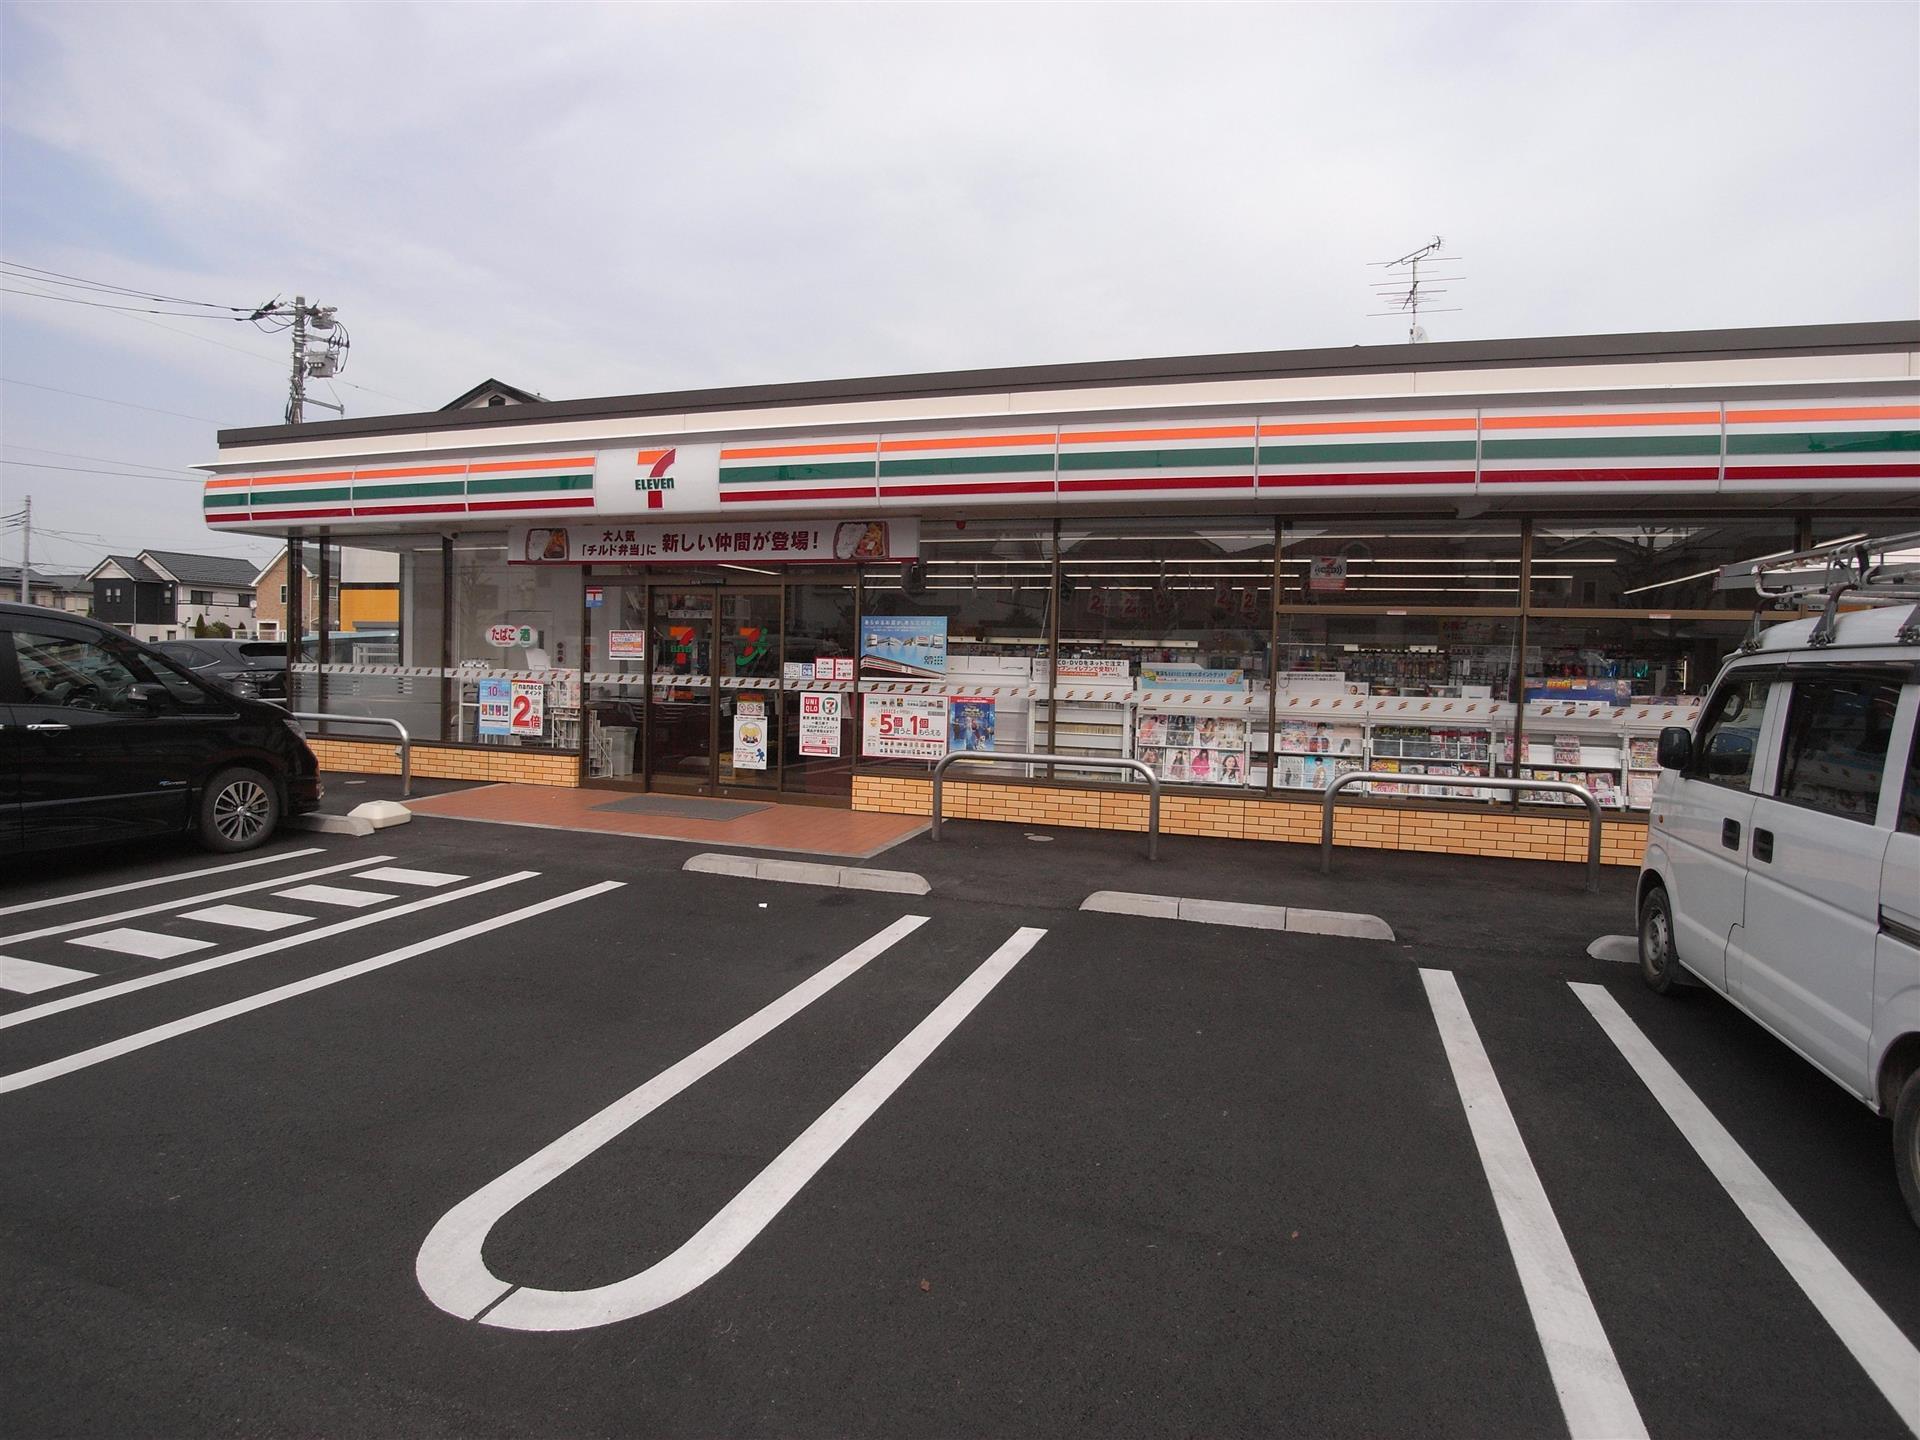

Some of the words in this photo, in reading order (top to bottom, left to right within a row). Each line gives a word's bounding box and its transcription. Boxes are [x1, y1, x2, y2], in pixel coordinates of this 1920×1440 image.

[637, 448, 677, 509] 7
[602, 530, 636, 542] 大人気
[662, 531, 819, 553] 新しい仲間が登場!
[582, 543, 657, 556] 「チルド弁当」に
[491, 628, 516, 641] たばこ
[520, 628, 530, 641] 酒
[805, 705, 818, 713] QLO
[919, 729, 942, 737] もらえる
